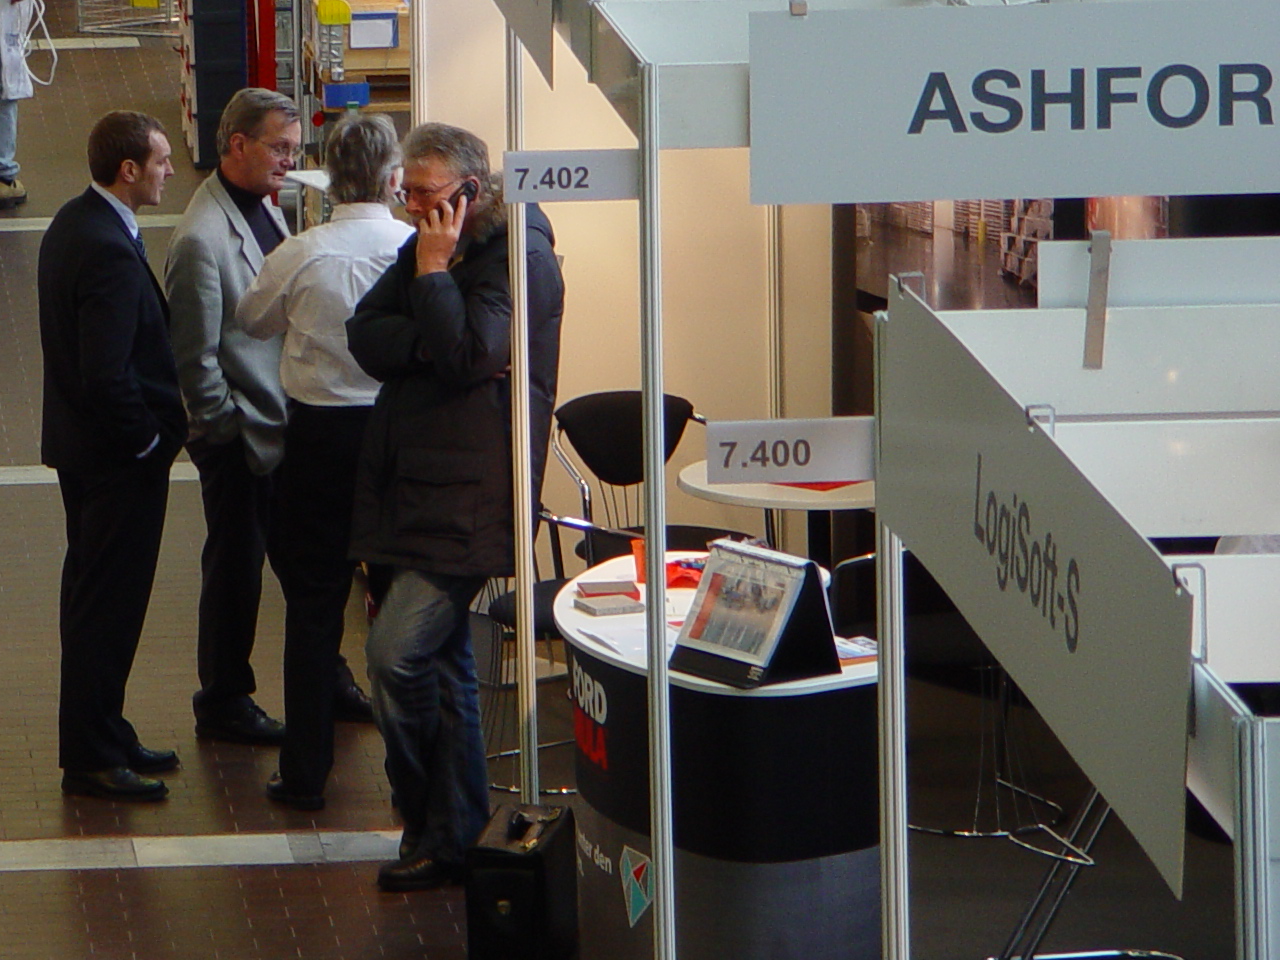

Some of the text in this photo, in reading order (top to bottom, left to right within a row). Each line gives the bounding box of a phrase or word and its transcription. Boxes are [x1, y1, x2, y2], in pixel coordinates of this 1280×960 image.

[907, 63, 1274, 135] ASHFOR
[513, 166, 590, 191] 7.402
[719, 439, 812, 470] 7.400
[974, 451, 1080, 654] LogiSoft-S
